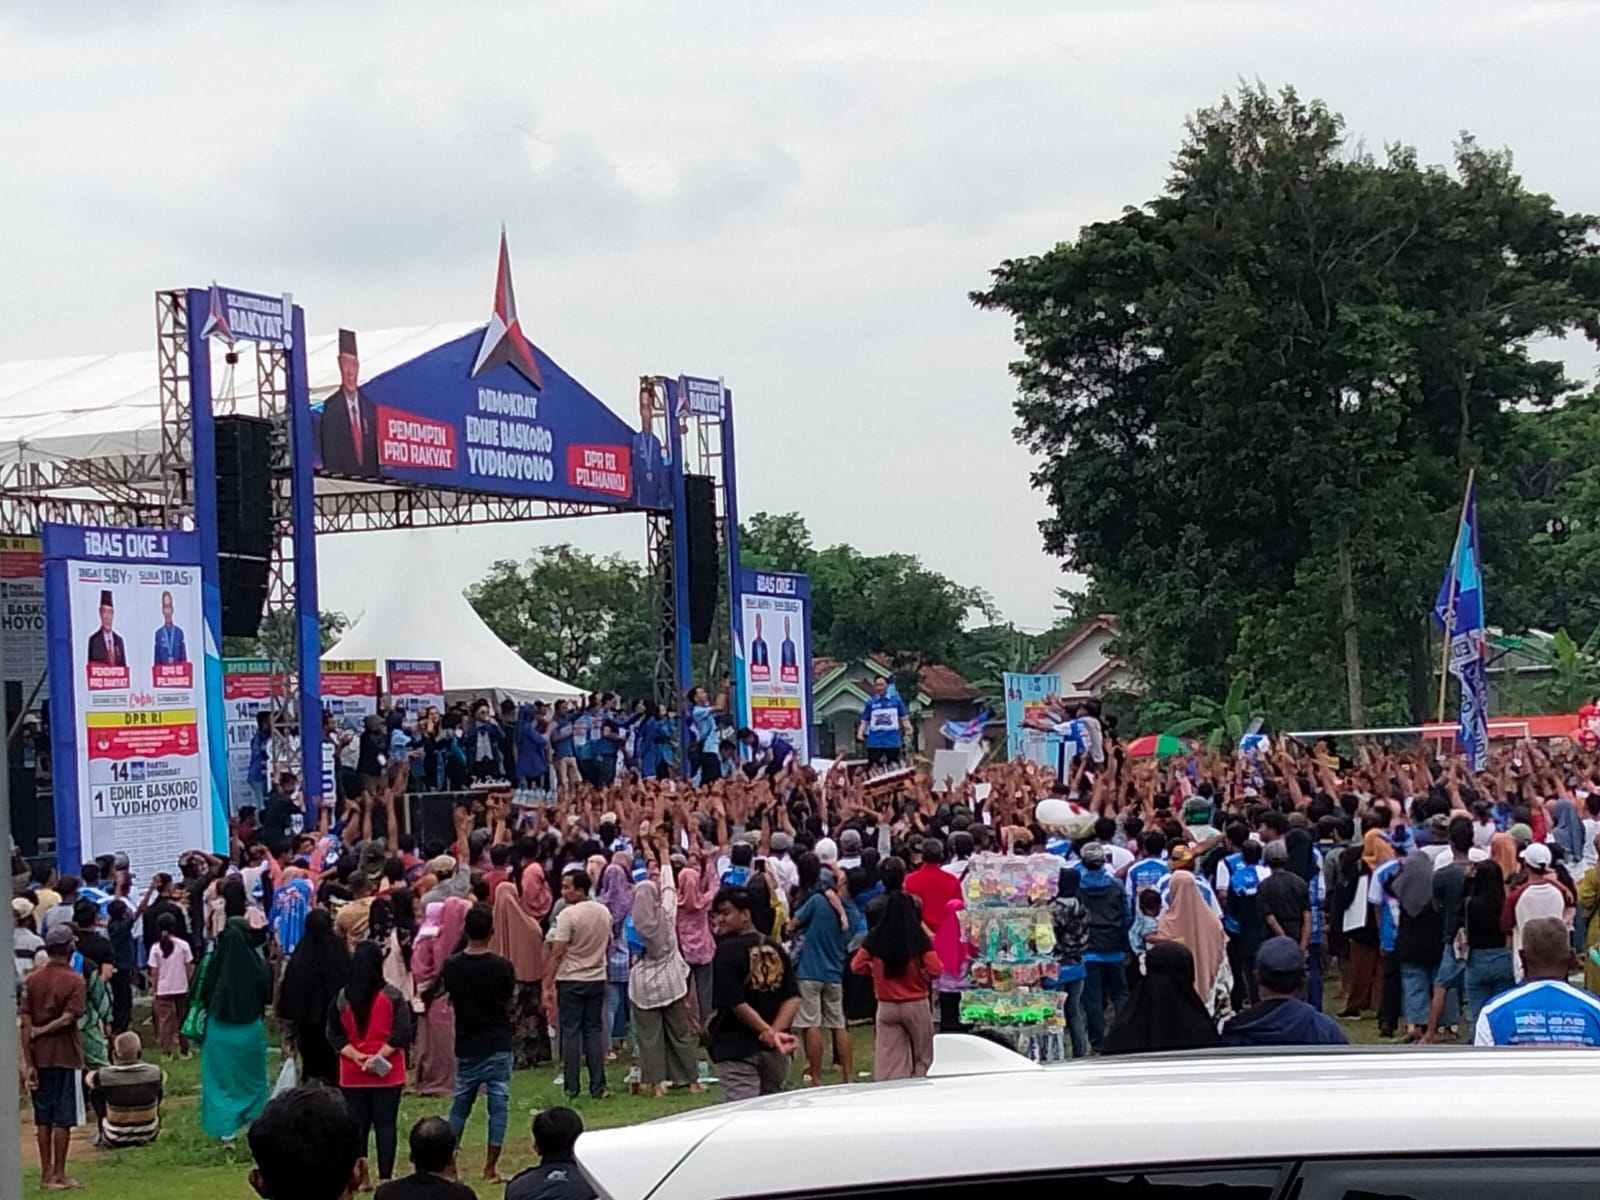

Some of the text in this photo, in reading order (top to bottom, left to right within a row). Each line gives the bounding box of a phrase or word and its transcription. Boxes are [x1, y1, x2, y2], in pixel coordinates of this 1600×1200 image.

[478, 387, 538, 419] DEMOKRAT
[388, 419, 446, 446] PEMIMPIN
[465, 415, 553, 453] EDHIE BASKORO
[384, 441, 453, 468] PRO RAKYAT
[467, 447, 554, 482] YUDHOYONO
[584, 450, 616, 471] DPR RI
[125, 711, 162, 725] DPR RI
[110, 762, 128, 781] 14
[94, 791, 104, 812] 1
[110, 781, 198, 801] EDHIE BASKORO
[111, 796, 199, 816] YUDHOYONO
